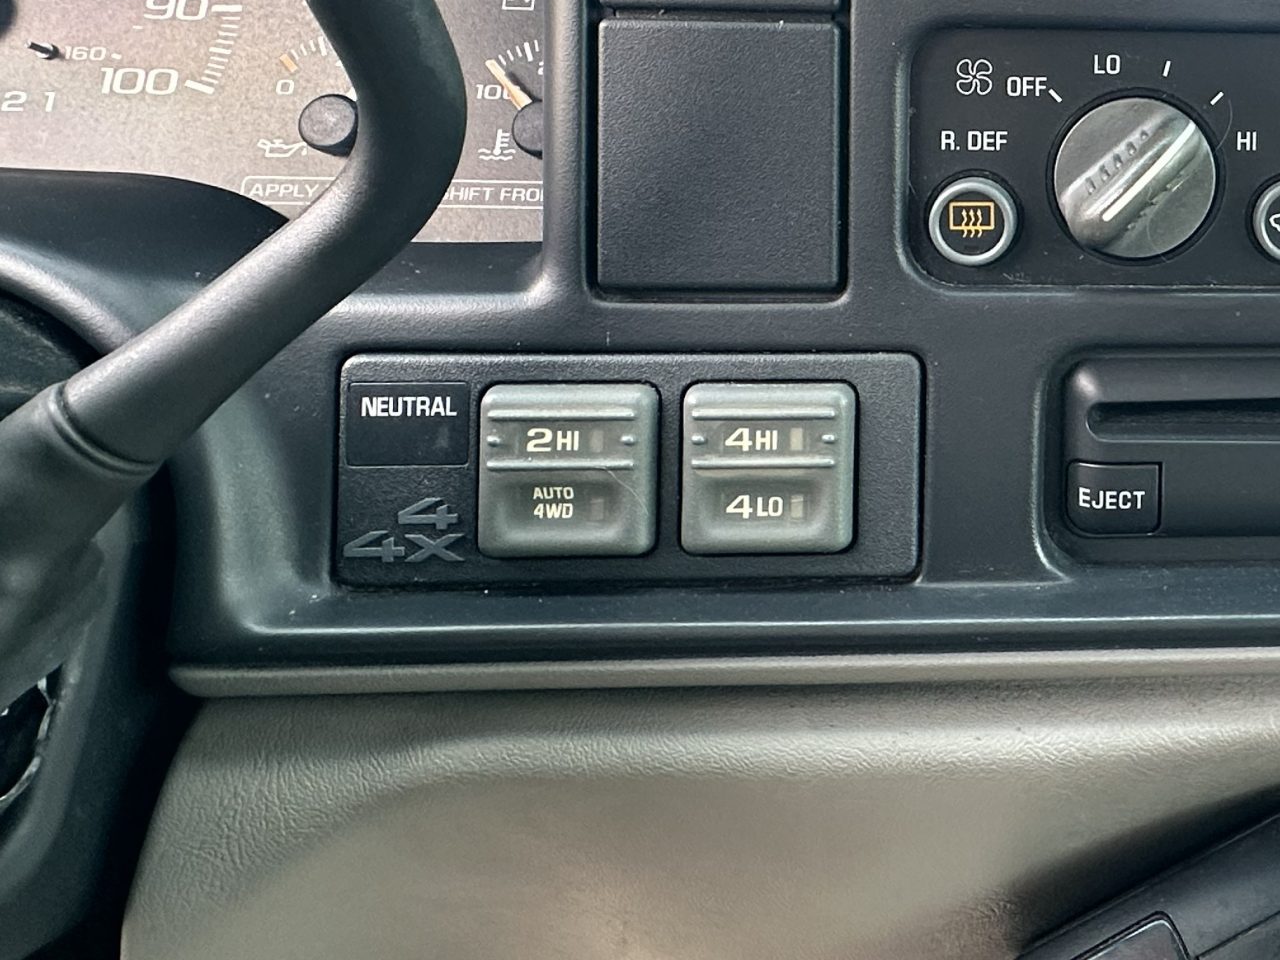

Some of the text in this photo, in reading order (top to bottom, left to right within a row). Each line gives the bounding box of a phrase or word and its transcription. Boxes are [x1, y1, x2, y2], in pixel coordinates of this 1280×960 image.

[64, 44, 107, 62] 160
[1093, 54, 1121, 75] LO
[100, 66, 180, 96] 100
[275, 78, 296, 96] 0
[1006, 76, 1048, 97] OFF
[1, 90, 56, 113] 2 1
[940, 130, 1008, 151] R. DEF
[1236, 131, 1257, 151] HI
[250, 183, 321, 199] APPLY
[500, 187, 543, 203] FRO
[361, 396, 458, 417] NEUTRAL
[532, 486, 575, 501] AUTO
[1078, 486, 1146, 510] EJECT
[533, 503, 574, 519] 4WD
